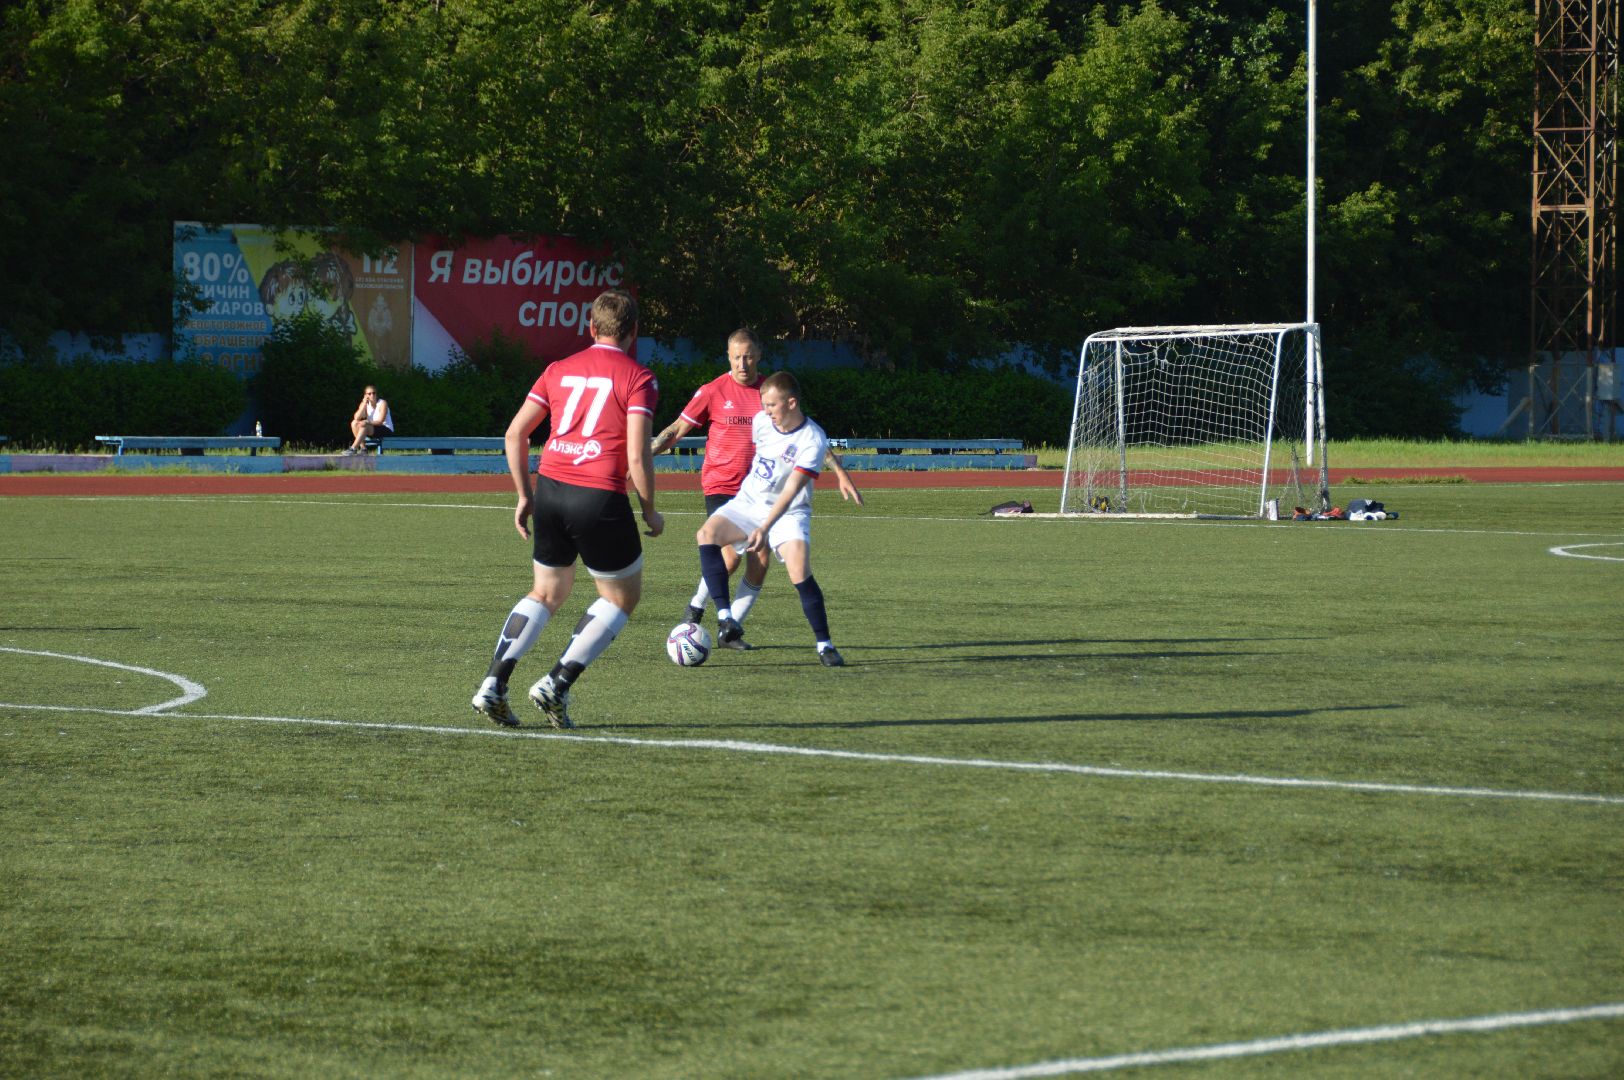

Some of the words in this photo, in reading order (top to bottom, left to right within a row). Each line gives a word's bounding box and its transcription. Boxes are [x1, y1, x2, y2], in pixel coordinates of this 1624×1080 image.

[183, 251, 249, 283] 80%
[427, 250, 455, 283] Я
[557, 375, 613, 437] 77
